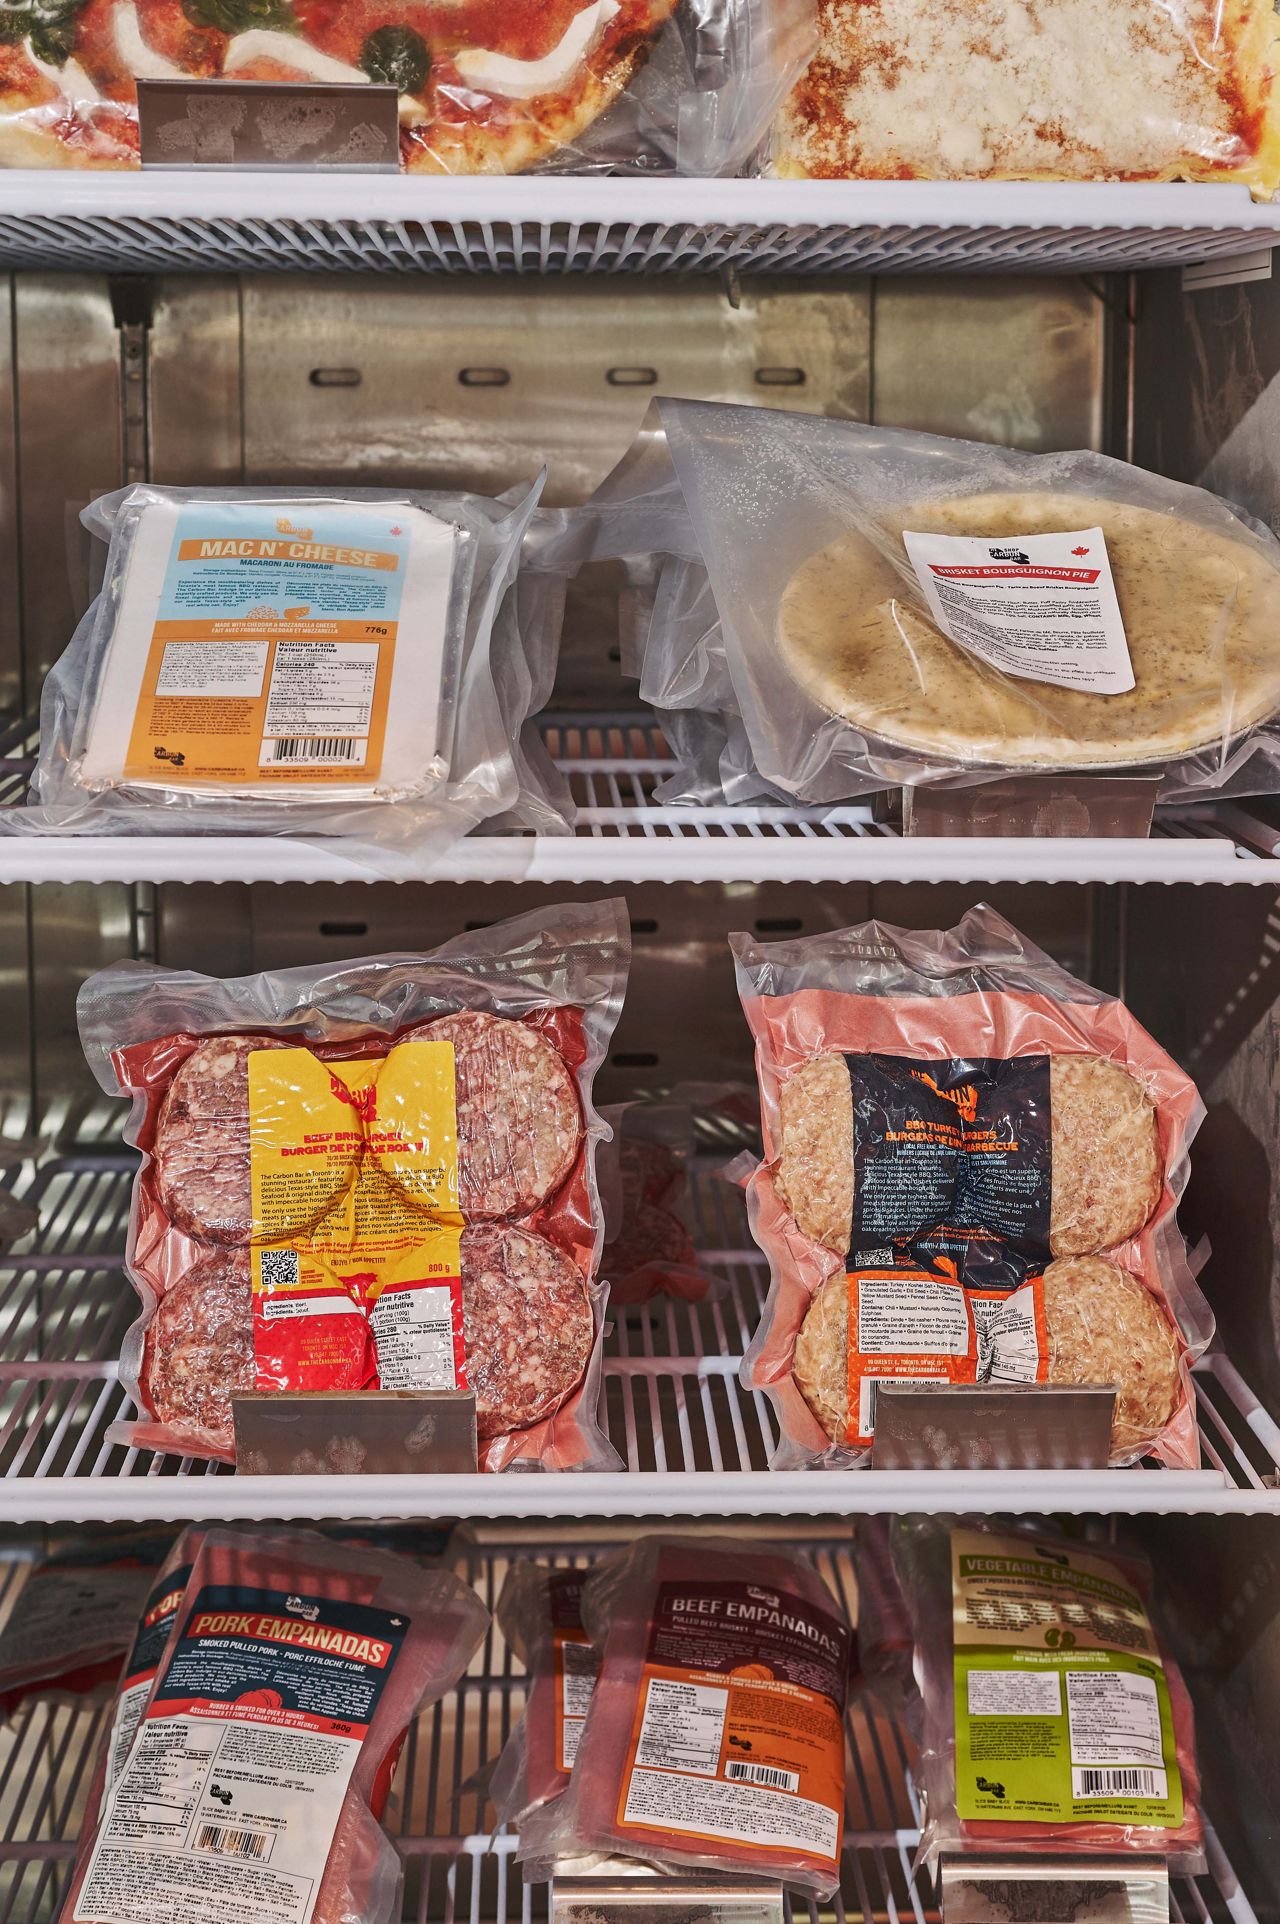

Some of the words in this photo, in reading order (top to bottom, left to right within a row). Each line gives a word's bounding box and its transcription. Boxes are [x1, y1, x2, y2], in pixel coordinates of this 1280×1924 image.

[200, 541, 254, 556] MAC
[259, 541, 284, 556] N'
[289, 543, 378, 567] CHEESE
[240, 559, 282, 567] MACARONI
[283, 560, 295, 568] AU
[296, 562, 334, 570] FROMAGE
[938, 567, 981, 575] BRISKET
[983, 567, 1070, 577] BOURGUIGNON
[365, 626, 387, 635] 776g
[927, 1122, 960, 1135] TURKEY
[964, 1131, 997, 1140] URGERS
[304, 1133, 333, 1144] BEEF
[886, 1132, 934, 1143] BURGERS
[281, 1145, 328, 1156] BURGER
[330, 1144, 345, 1153] DE
[967, 1142, 1018, 1152] BARBECUE
[428, 1263, 443, 1272] 800
[445, 1264, 450, 1273] g
[394, 1292, 411, 1303] Facts
[387, 1302, 414, 1313] nutritive
[941, 1306, 961, 1314] Occurring
[395, 1310, 410, 1319] (100g)
[379, 1318, 394, 1326] portion
[395, 1316, 411, 1324] (100g)
[967, 1559, 1047, 1576] VEGETABLE
[672, 1598, 722, 1614] BEEF
[726, 1602, 840, 1657] EMPANADAS
[195, 1616, 255, 1634] PORK
[256, 1618, 385, 1664] EMPANADAS
[198, 1639, 229, 1648] SMOKED
[229, 1641, 258, 1652] PULLED
[258, 1646, 279, 1656] PORK
[284, 1651, 304, 1661] PORC
[305, 1656, 345, 1669] EFFILOCHÉ
[345, 1662, 366, 1673] FUMÉ
[672, 1689, 697, 1697] nutritive
[679, 1684, 695, 1692] Facts
[209, 1702, 230, 1710] RUBBED
[266, 1708, 280, 1716] OVER
[190, 1707, 224, 1717] ASSAISONNER
[231, 1710, 245, 1719] FUMÉ
[246, 1713, 268, 1722] PENDANT
[268, 1716, 283, 1724] PLUS
[330, 1722, 352, 1732] 360g
